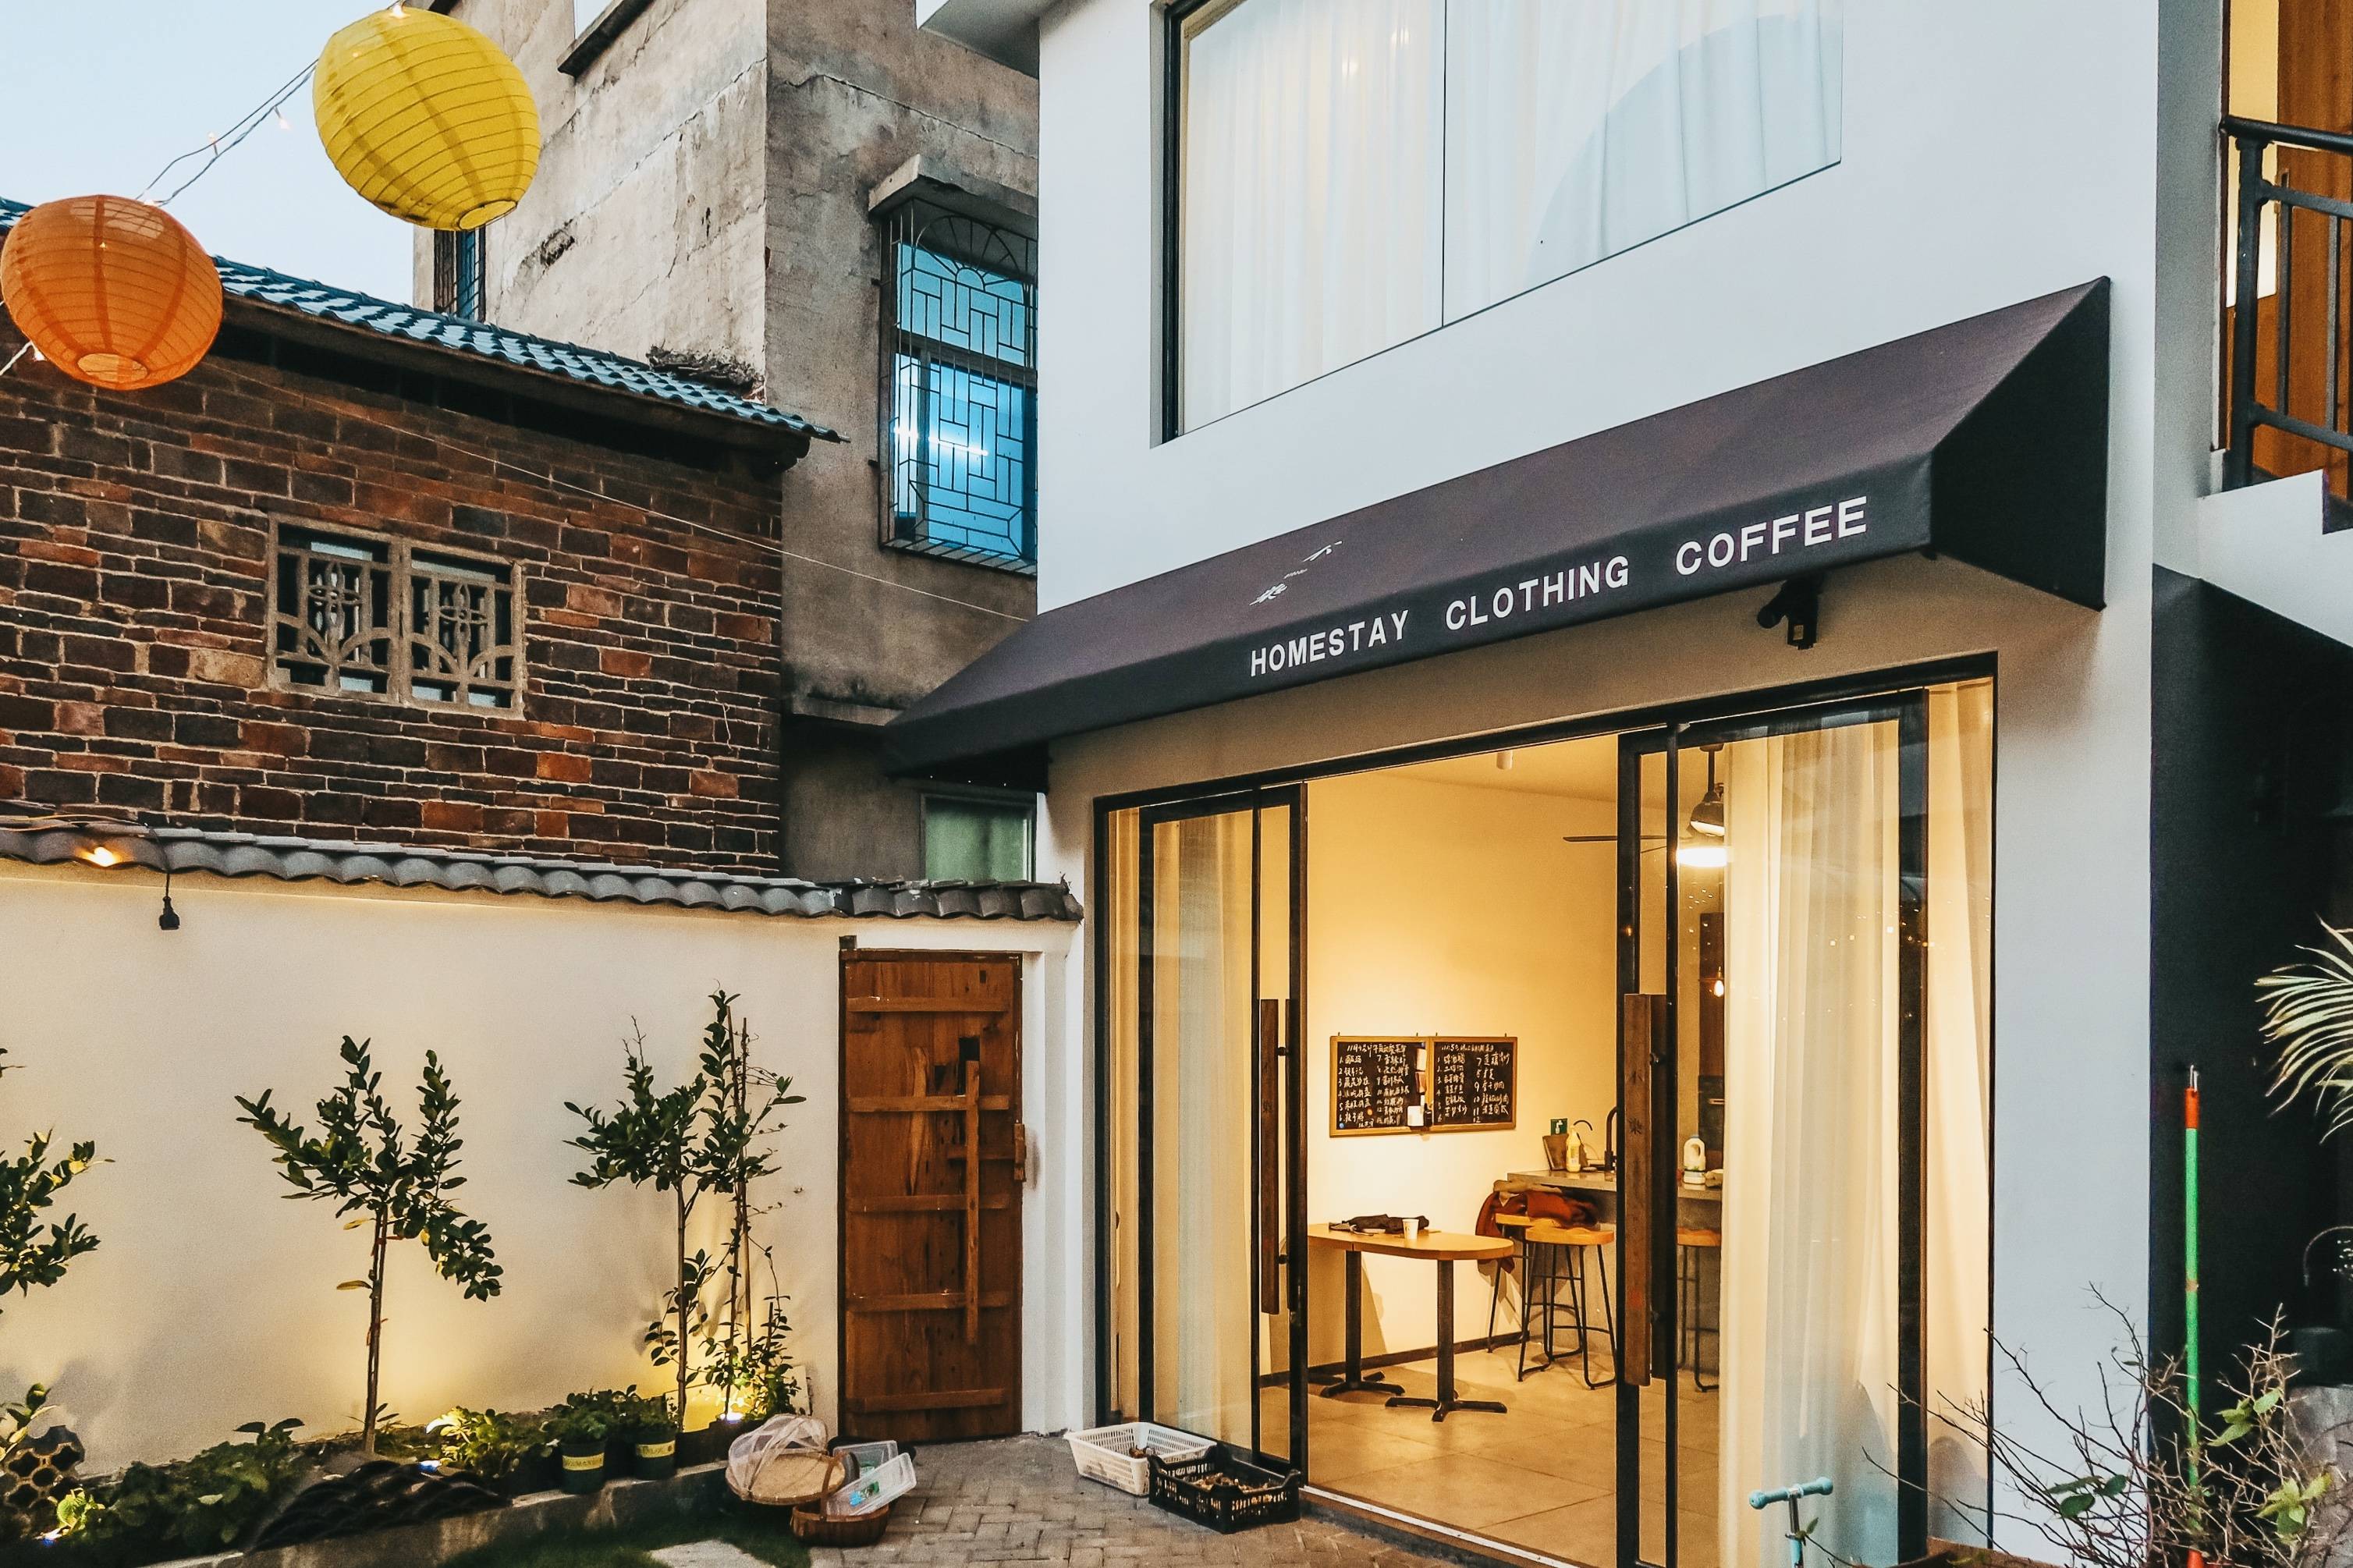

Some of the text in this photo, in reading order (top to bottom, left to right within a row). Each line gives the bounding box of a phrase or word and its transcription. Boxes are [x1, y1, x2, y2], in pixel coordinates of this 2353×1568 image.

[1251, 496, 1866, 676] HOMESTAY CLOTHING COFFEE
